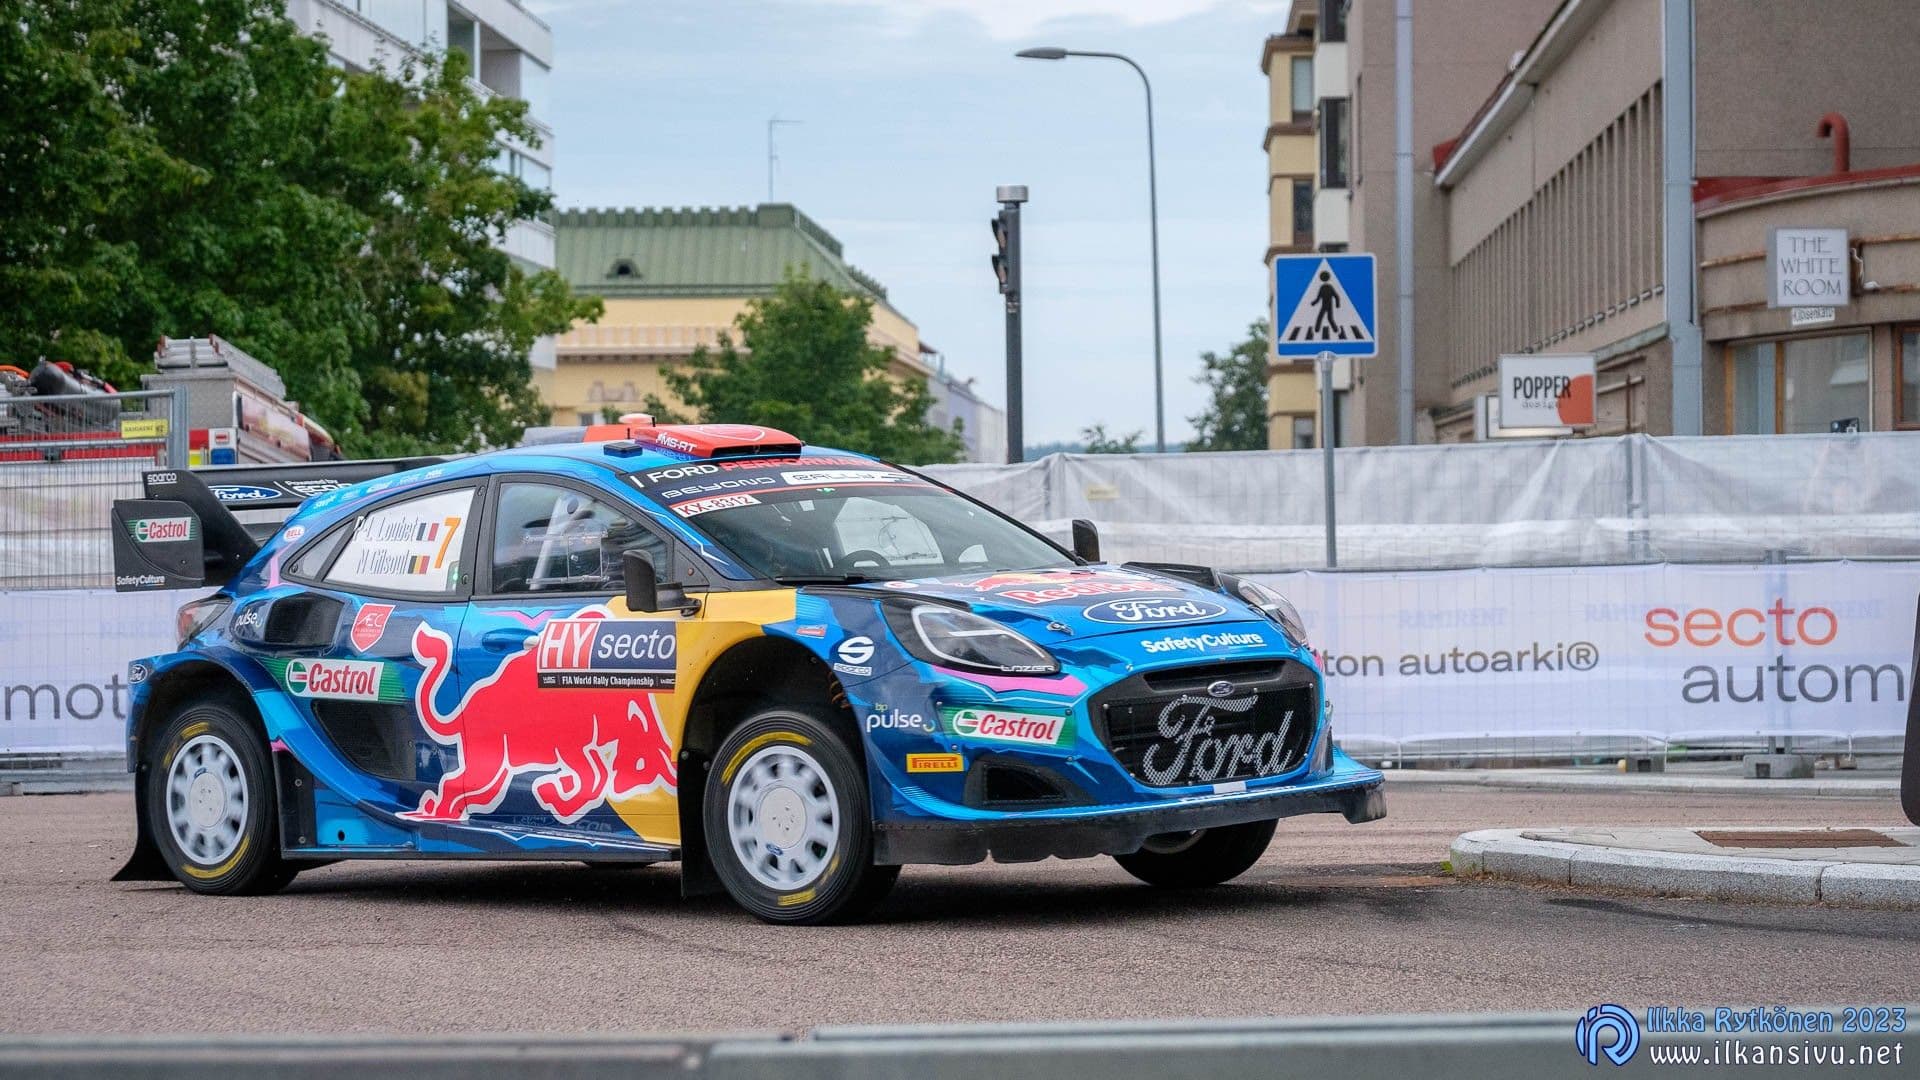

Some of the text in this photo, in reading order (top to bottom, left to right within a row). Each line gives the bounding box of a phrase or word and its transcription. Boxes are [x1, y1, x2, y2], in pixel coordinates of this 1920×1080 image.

[1786, 236, 1832, 254] THE
[1781, 257, 1842, 275] WHITE
[1783, 278, 1842, 296] ROOM
[1513, 375, 1572, 399] POPPER
[147, 472, 177, 483] sparco
[647, 464, 719, 483] FORD
[213, 487, 268, 500] Ford
[662, 476, 776, 499] BEYOND
[680, 495, 753, 516] KX-8312
[149, 520, 187, 539] Castrol
[434, 516, 461, 569] 7
[116, 574, 165, 587] SafetyCulture
[236, 608, 258, 628] pulse
[1108, 599, 1207, 621] Ford
[1644, 597, 1838, 647] secto
[541, 622, 676, 668] HY secto
[1140, 632, 1264, 653] SafetyCulture
[308, 663, 377, 695] Castrol
[562, 676, 573, 685] FIA
[574, 676, 592, 685] World
[593, 676, 609, 687] Rally
[610, 676, 655, 688] Championship
[1682, 655, 1905, 704] autom
[874, 702, 888, 713] bp
[866, 709, 923, 733] pulse
[979, 713, 1057, 741] Castrol
[1142, 694, 1295, 786] Ford
[911, 756, 959, 770] PIRELLI
